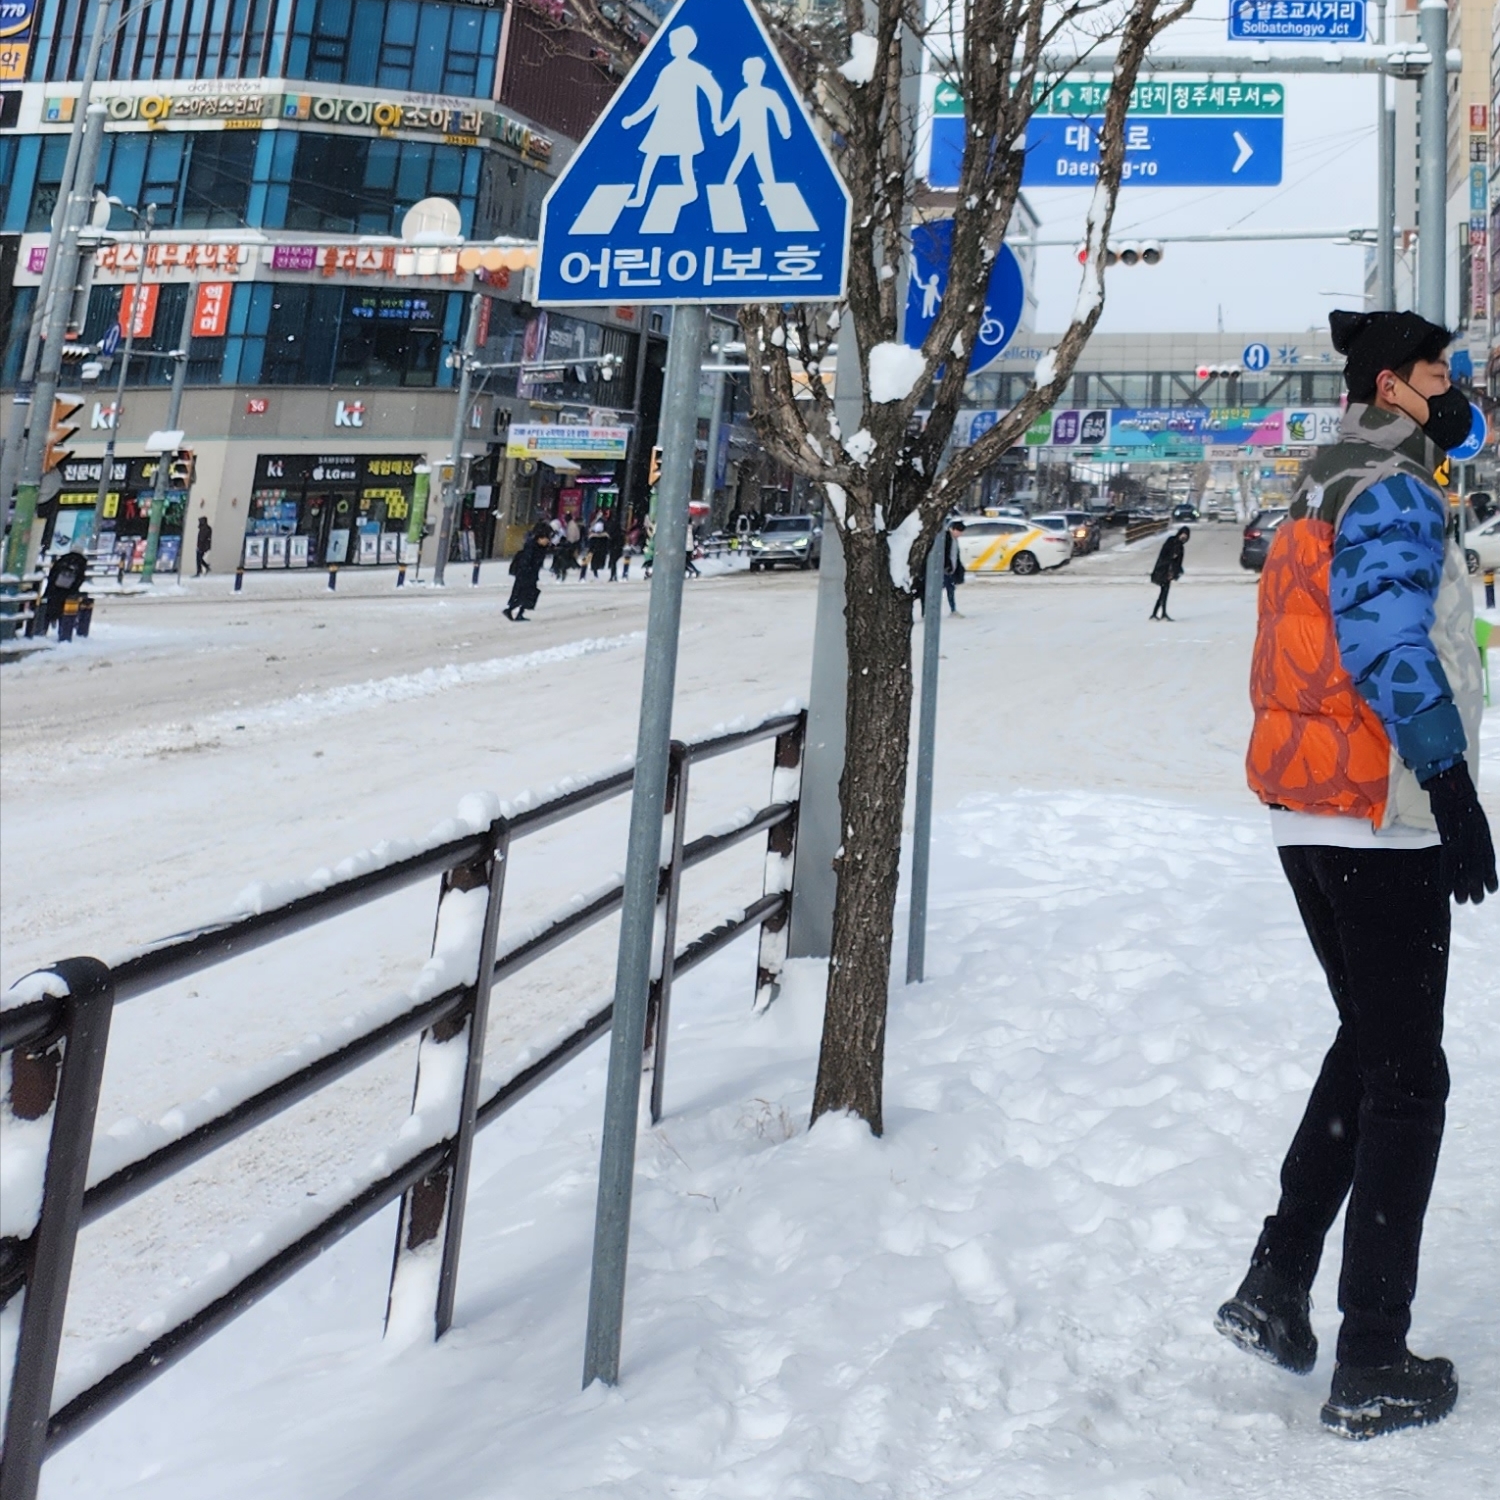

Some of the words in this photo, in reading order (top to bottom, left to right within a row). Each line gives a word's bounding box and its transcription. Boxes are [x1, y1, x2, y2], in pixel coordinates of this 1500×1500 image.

[1237, 0, 1356, 24] 솔밭초교사거리
[1242, 21, 1325, 38] Solbatchogyo
[1328, 22, 1351, 36] Jct
[1173, 86, 1260, 109] 청주세무서
[1064, 125, 1152, 153] 대로
[1056, 158, 1158, 179] Daeng-ro
[560, 243, 824, 289] 어린이보호
[334, 400, 366, 427] kt
[267, 460, 284, 477] kt
